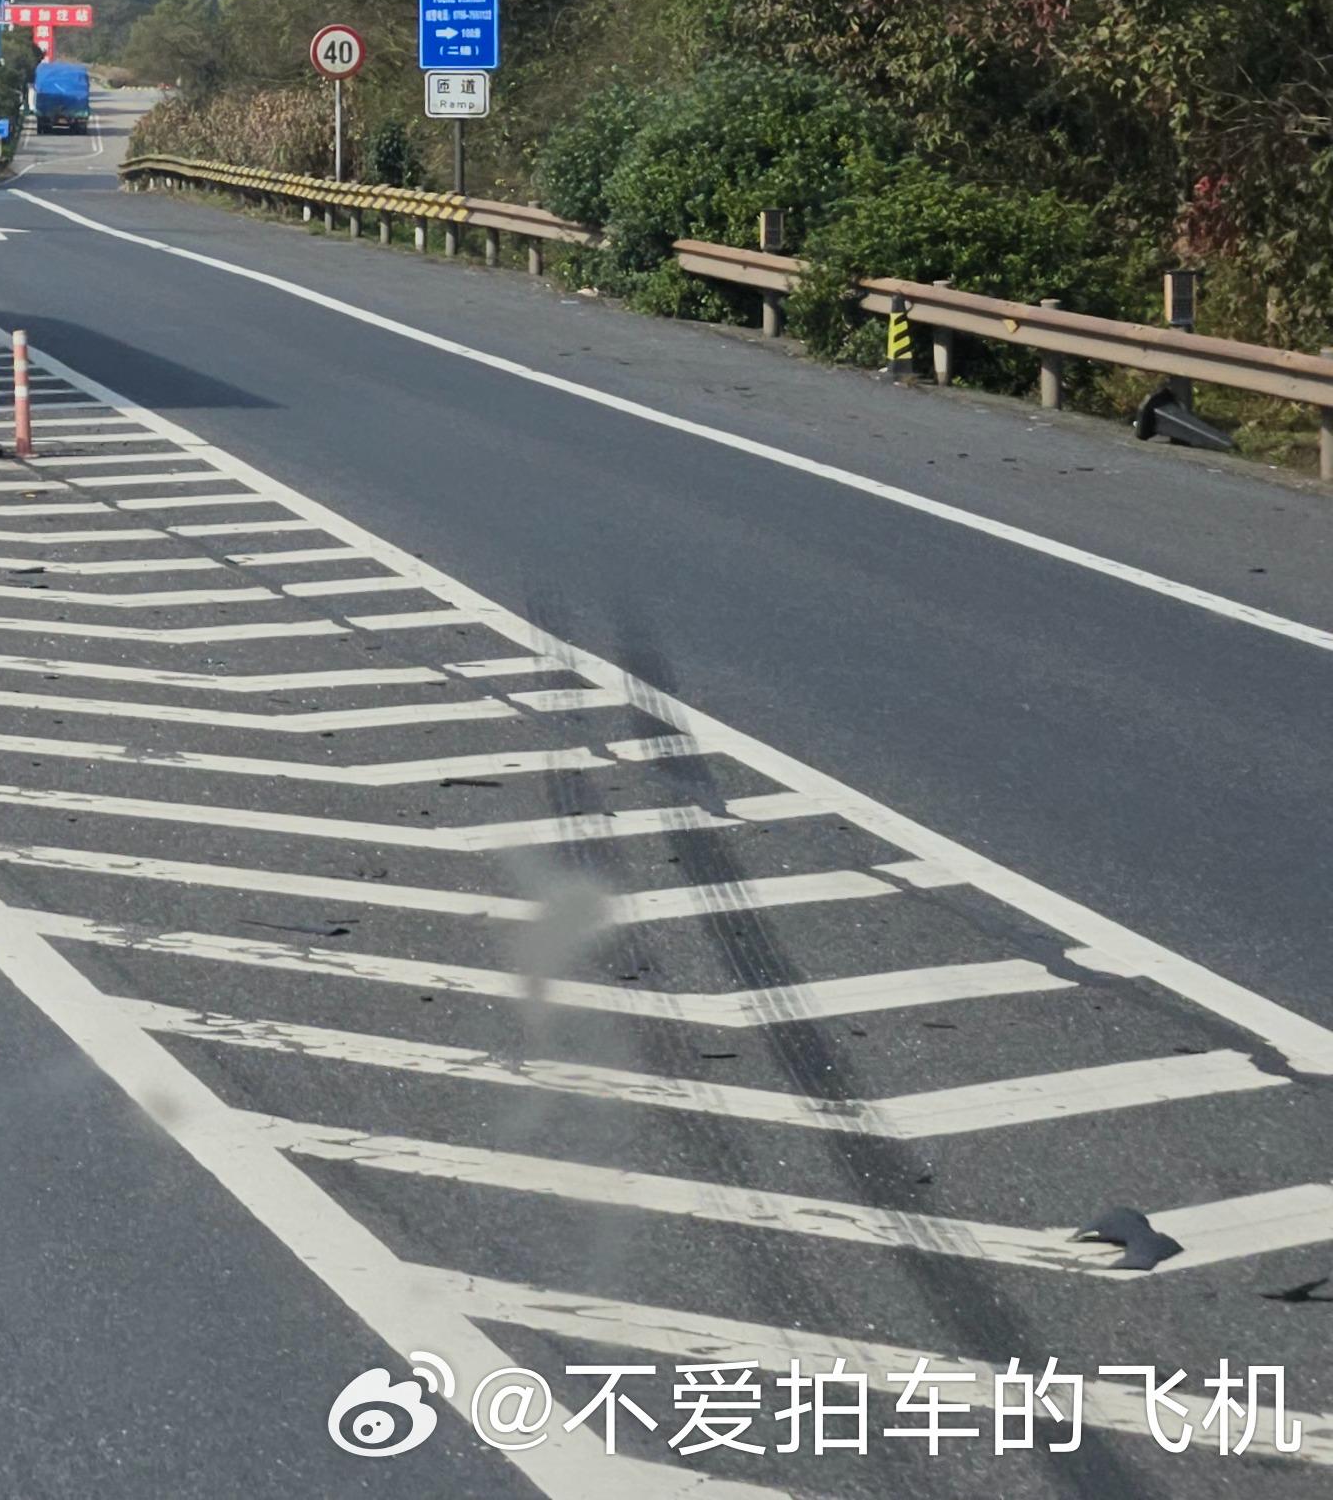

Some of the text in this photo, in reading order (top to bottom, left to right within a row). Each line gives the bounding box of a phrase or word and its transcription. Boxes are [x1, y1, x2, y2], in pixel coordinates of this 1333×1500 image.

[323, 40, 353, 64] 40
[437, 78, 476, 94] 匝道
[439, 100, 476, 110] Ramp
